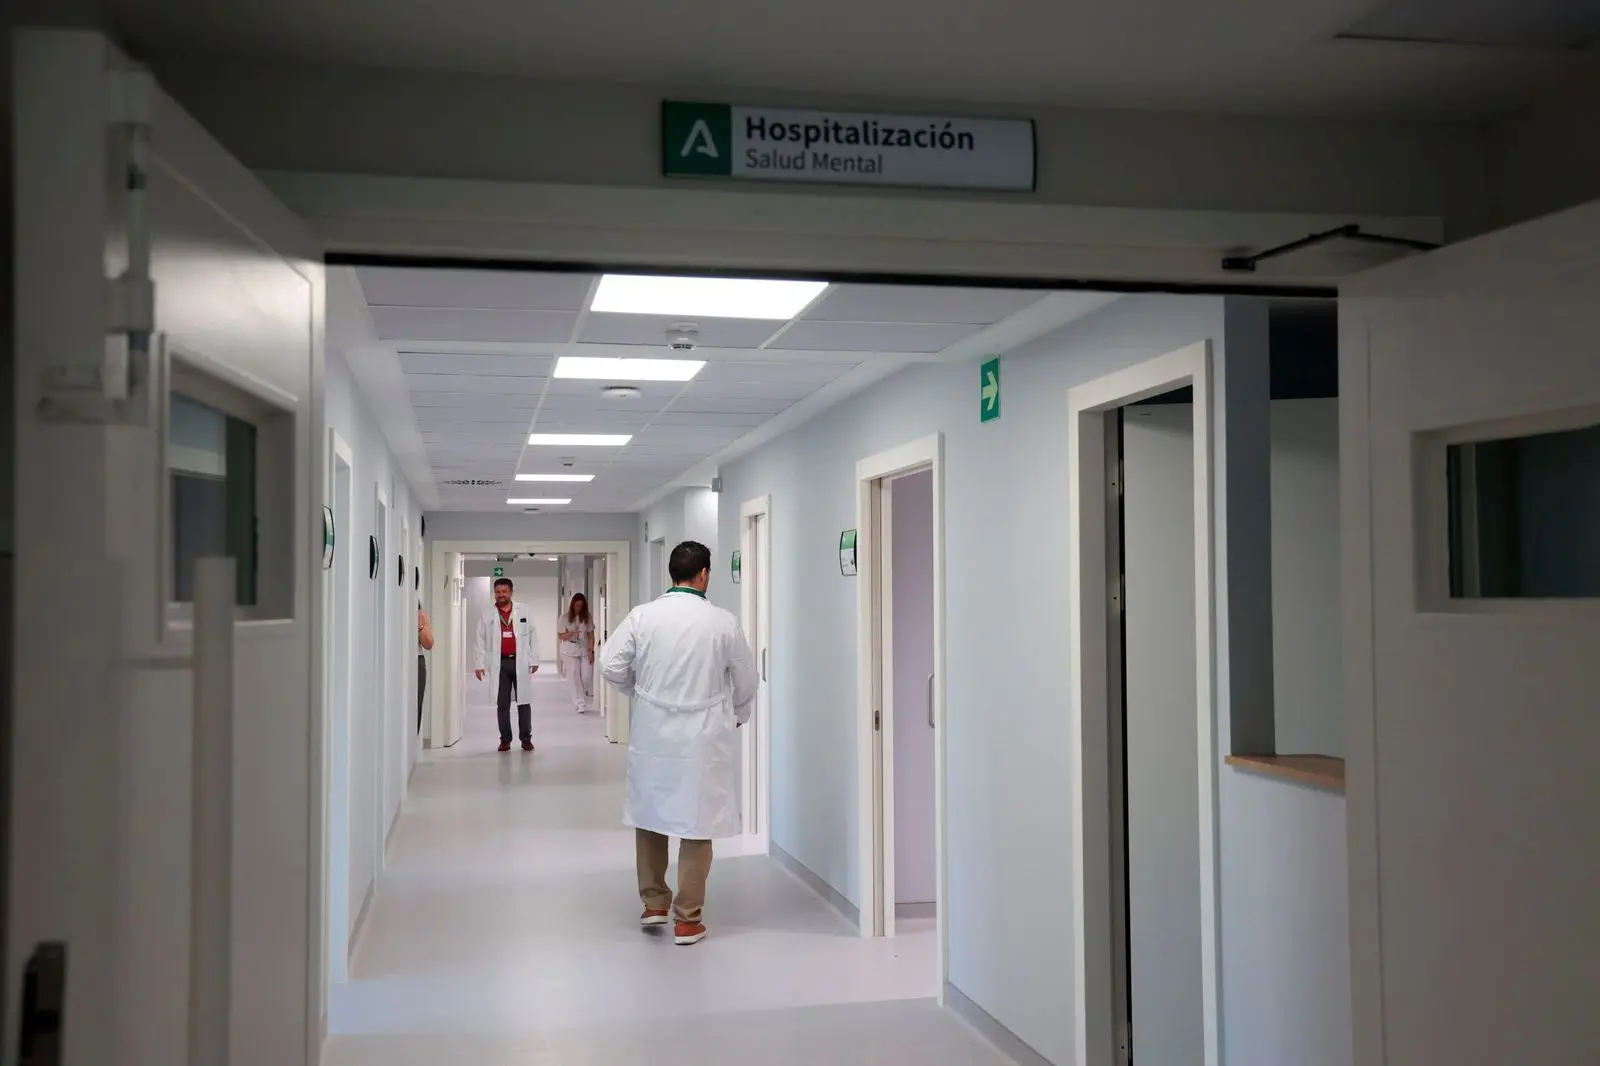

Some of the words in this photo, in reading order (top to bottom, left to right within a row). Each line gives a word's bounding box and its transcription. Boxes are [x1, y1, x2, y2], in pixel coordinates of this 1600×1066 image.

[745, 116, 975, 151] Hospitalización
[745, 148, 806, 171] Salud
[812, 152, 883, 174] Mental
